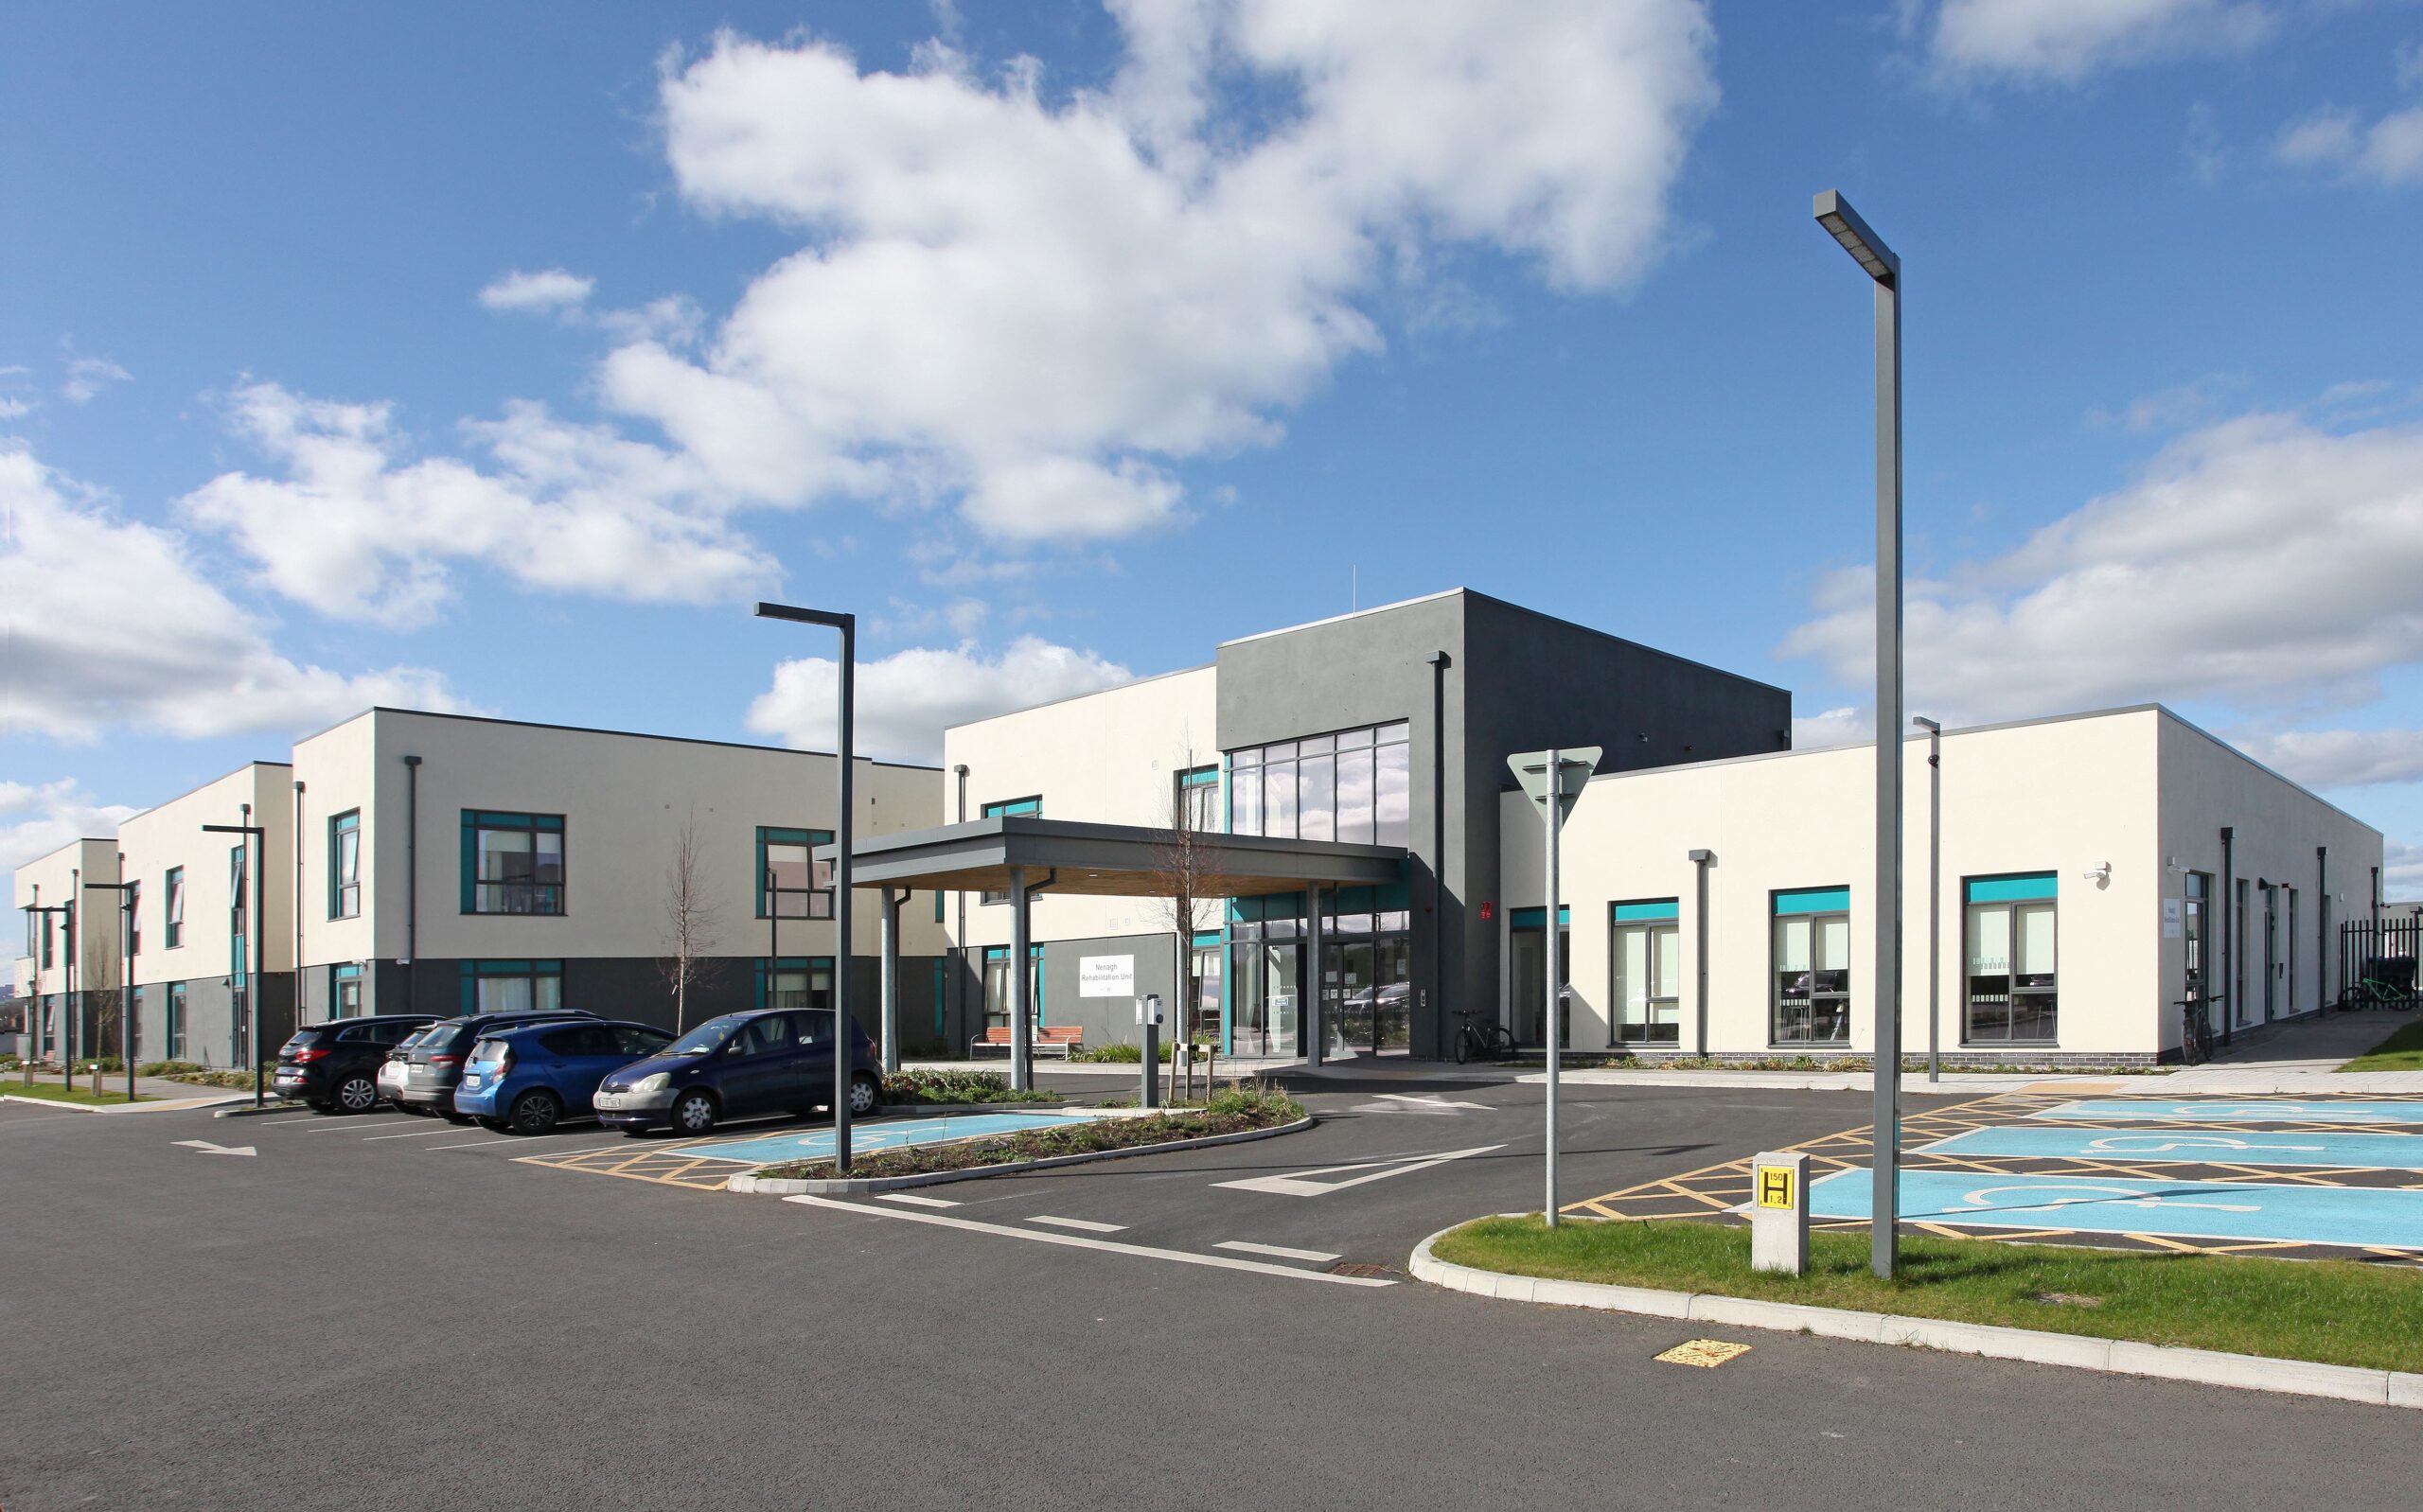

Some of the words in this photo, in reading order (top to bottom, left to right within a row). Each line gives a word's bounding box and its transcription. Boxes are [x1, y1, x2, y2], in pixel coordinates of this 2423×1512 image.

[1095, 963, 1118, 972] Nenagh
[1770, 1172, 1783, 1181] 150
[1763, 1171, 1788, 1204] H
